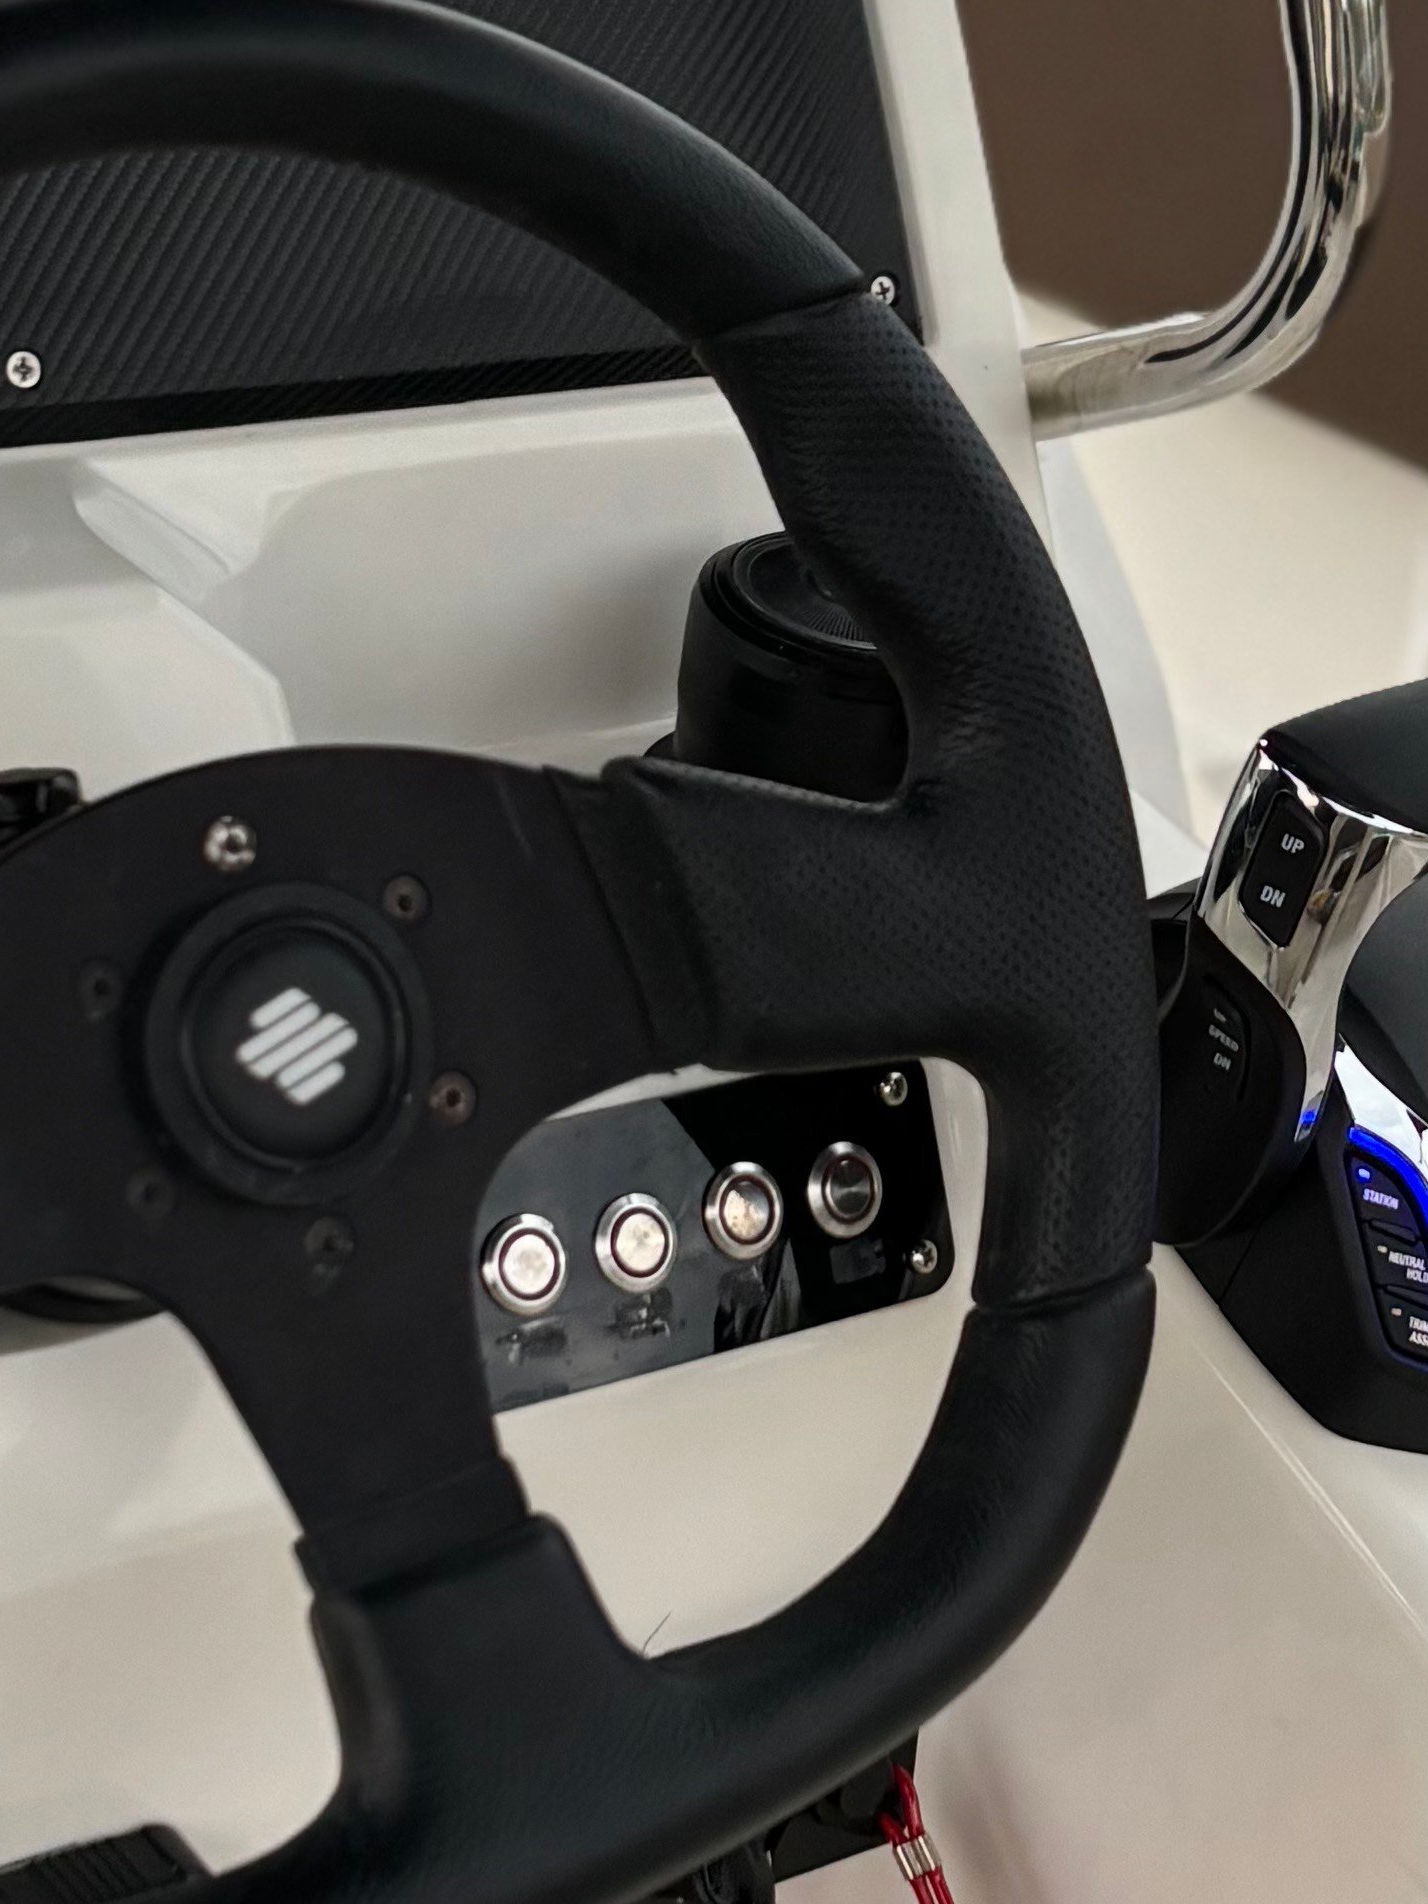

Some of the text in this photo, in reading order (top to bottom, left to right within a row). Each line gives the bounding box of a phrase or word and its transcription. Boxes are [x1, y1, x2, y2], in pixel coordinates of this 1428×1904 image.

[1281, 834, 1305, 853] UP
[1260, 885, 1286, 908] DN
[1208, 1024, 1239, 1052] SPEED
[1213, 1052, 1231, 1070] DN
[1363, 1188, 1400, 1210] STATION
[1388, 1250, 1426, 1271] NEUTRAL
